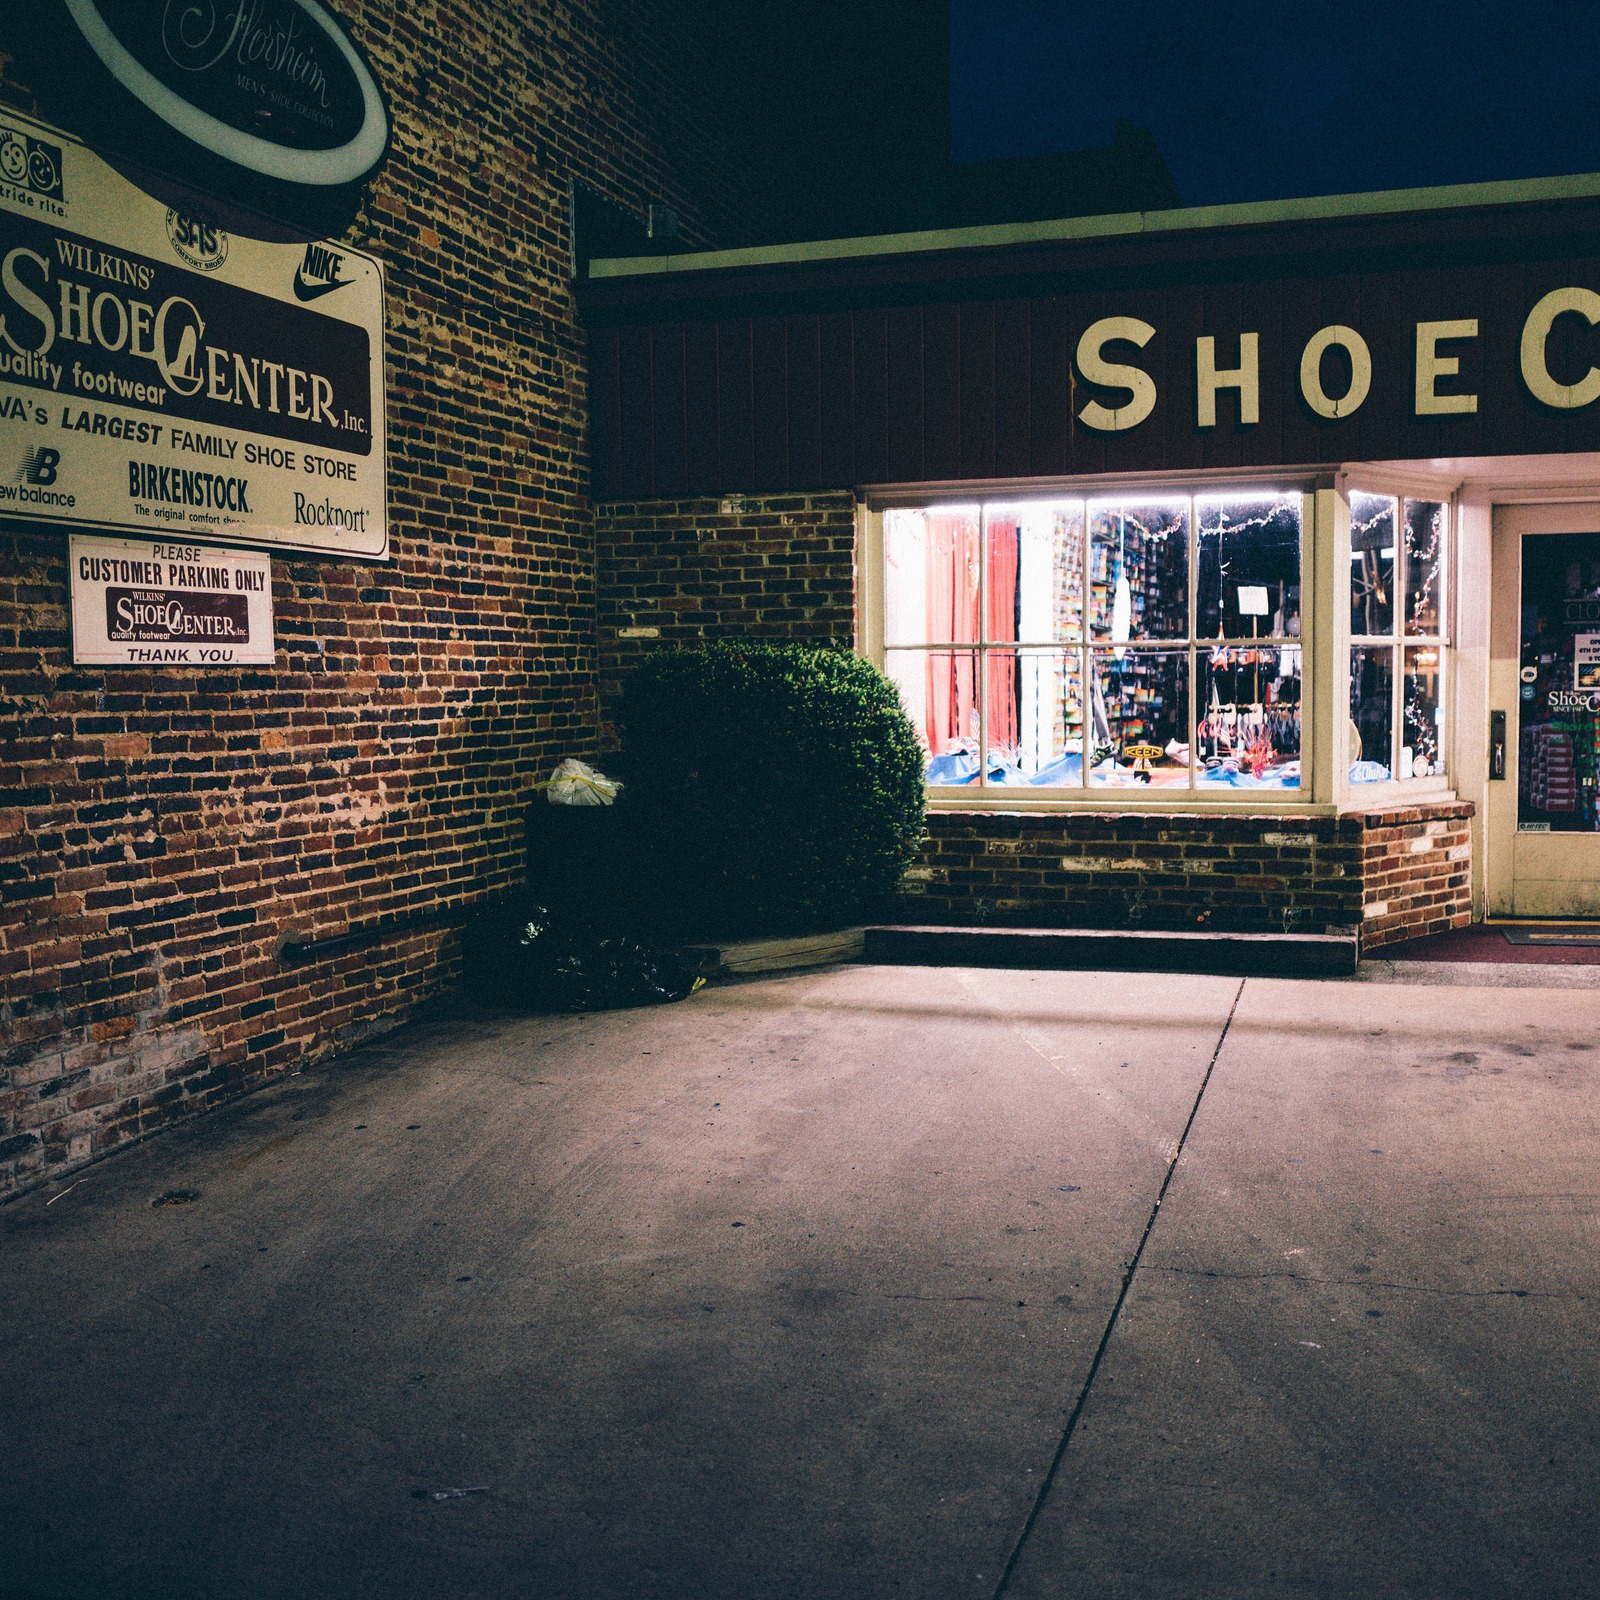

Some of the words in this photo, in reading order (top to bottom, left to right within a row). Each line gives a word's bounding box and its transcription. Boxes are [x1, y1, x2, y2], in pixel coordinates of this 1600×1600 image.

[40, 199, 64, 217] rite
[54, 237, 155, 290] WILKINS'
[171, 237, 203, 269] COMFORT
[204, 254, 224, 270] SHOES
[302, 243, 344, 283] NIKE
[72, 361, 167, 406] footwear
[61, 407, 162, 445] LARGEST
[171, 430, 238, 459] FAMILY
[244, 444, 296, 470] SHOE
[303, 454, 358, 482] STORE
[19, 485, 76, 508] balance
[129, 460, 249, 514] BIRKENSTOCK
[134, 503, 151, 516] The
[154, 505, 185, 521] original
[188, 511, 220, 525] comfort
[152, 545, 201, 562] PLEASE
[79, 556, 163, 586] CUSTOMER
[169, 564, 230, 590] PARKING
[235, 569, 266, 592] ONLY
[111, 629, 137, 641] quality
[139, 630, 171, 641] footwear
[127, 648, 190, 662] THANK
[198, 649, 234, 662] YOU
[1126, 747, 1161, 755] KEEN
